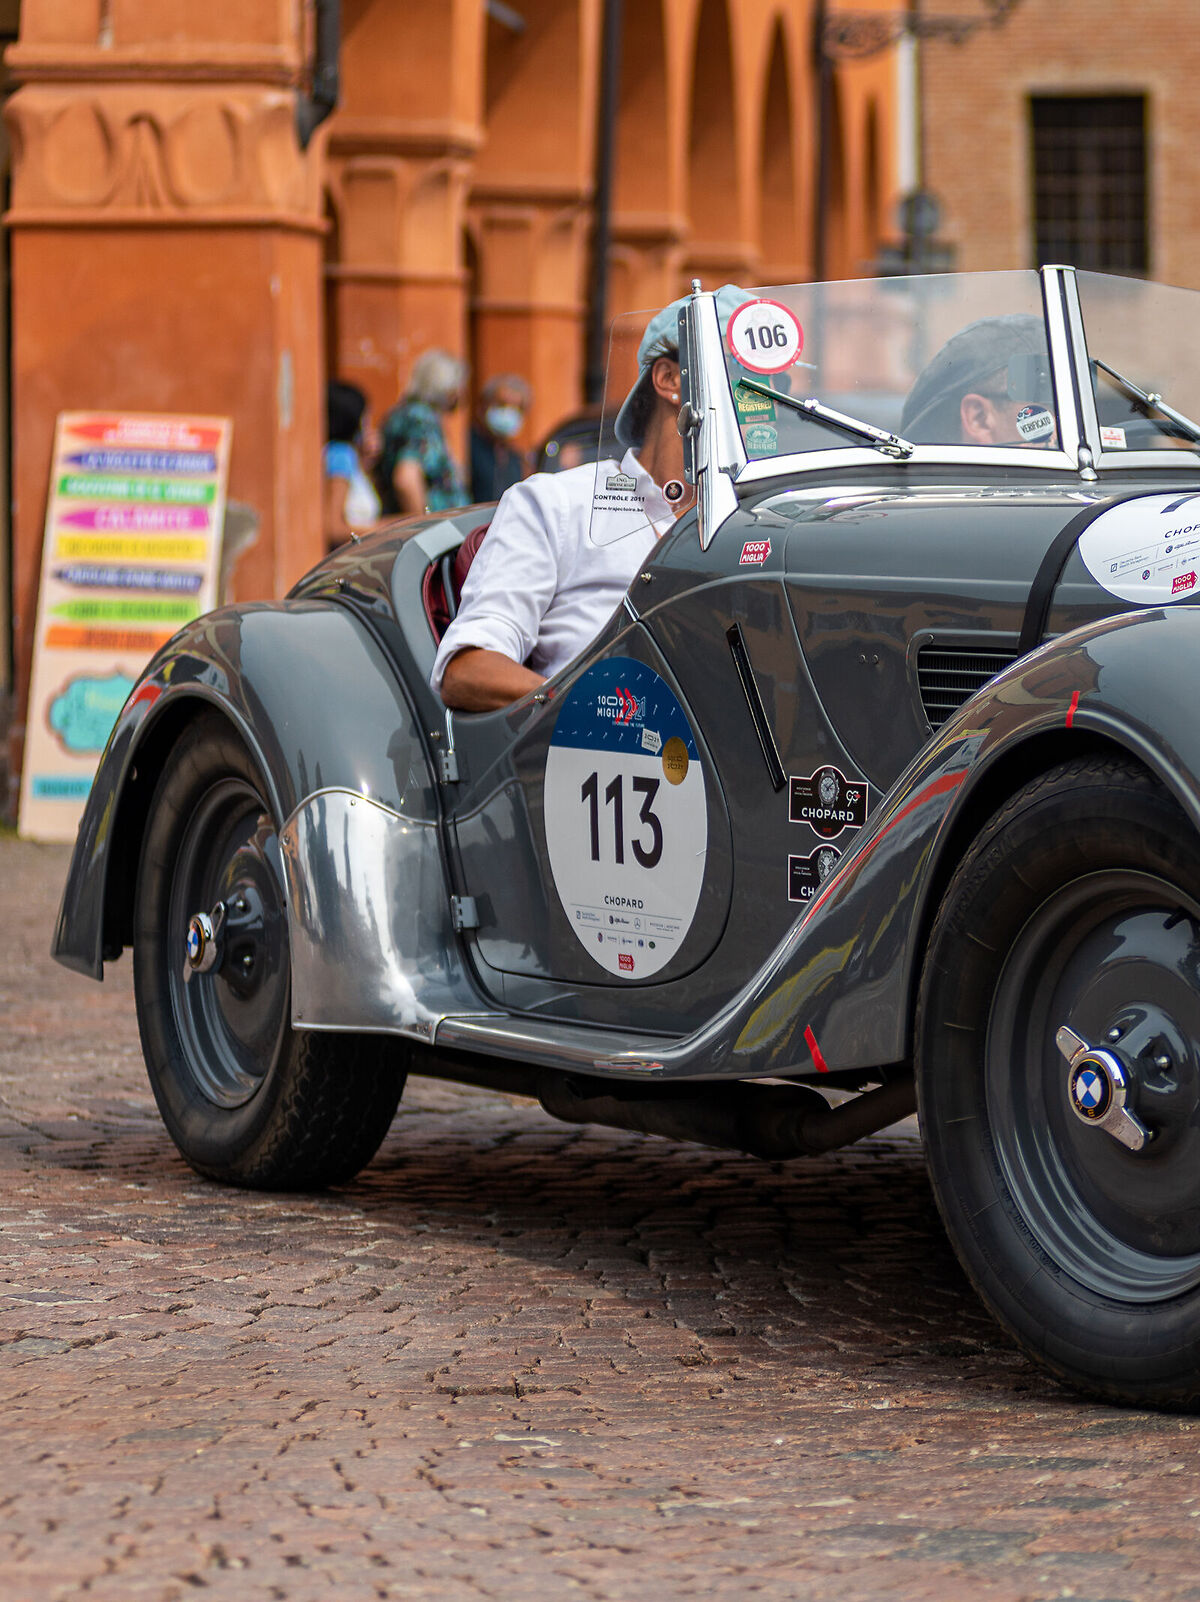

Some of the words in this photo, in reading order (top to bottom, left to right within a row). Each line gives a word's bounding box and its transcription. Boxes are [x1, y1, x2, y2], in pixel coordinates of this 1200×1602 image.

[745, 324, 787, 350] 106
[738, 402, 772, 412] REGISTERED
[1020, 416, 1051, 433] VERIFICATO
[594, 494, 629, 502] CONTRÔLE
[746, 543, 765, 552] 1000
[742, 553, 764, 562] MIGLIA
[1174, 573, 1192, 584] 1000
[1172, 582, 1193, 593] MIGLIA
[597, 695, 624, 706] 1000
[597, 707, 624, 718] MIGLIA
[581, 771, 663, 869] 113
[801, 807, 854, 822] CHOPARD
[604, 895, 644, 909] CHOPARD
